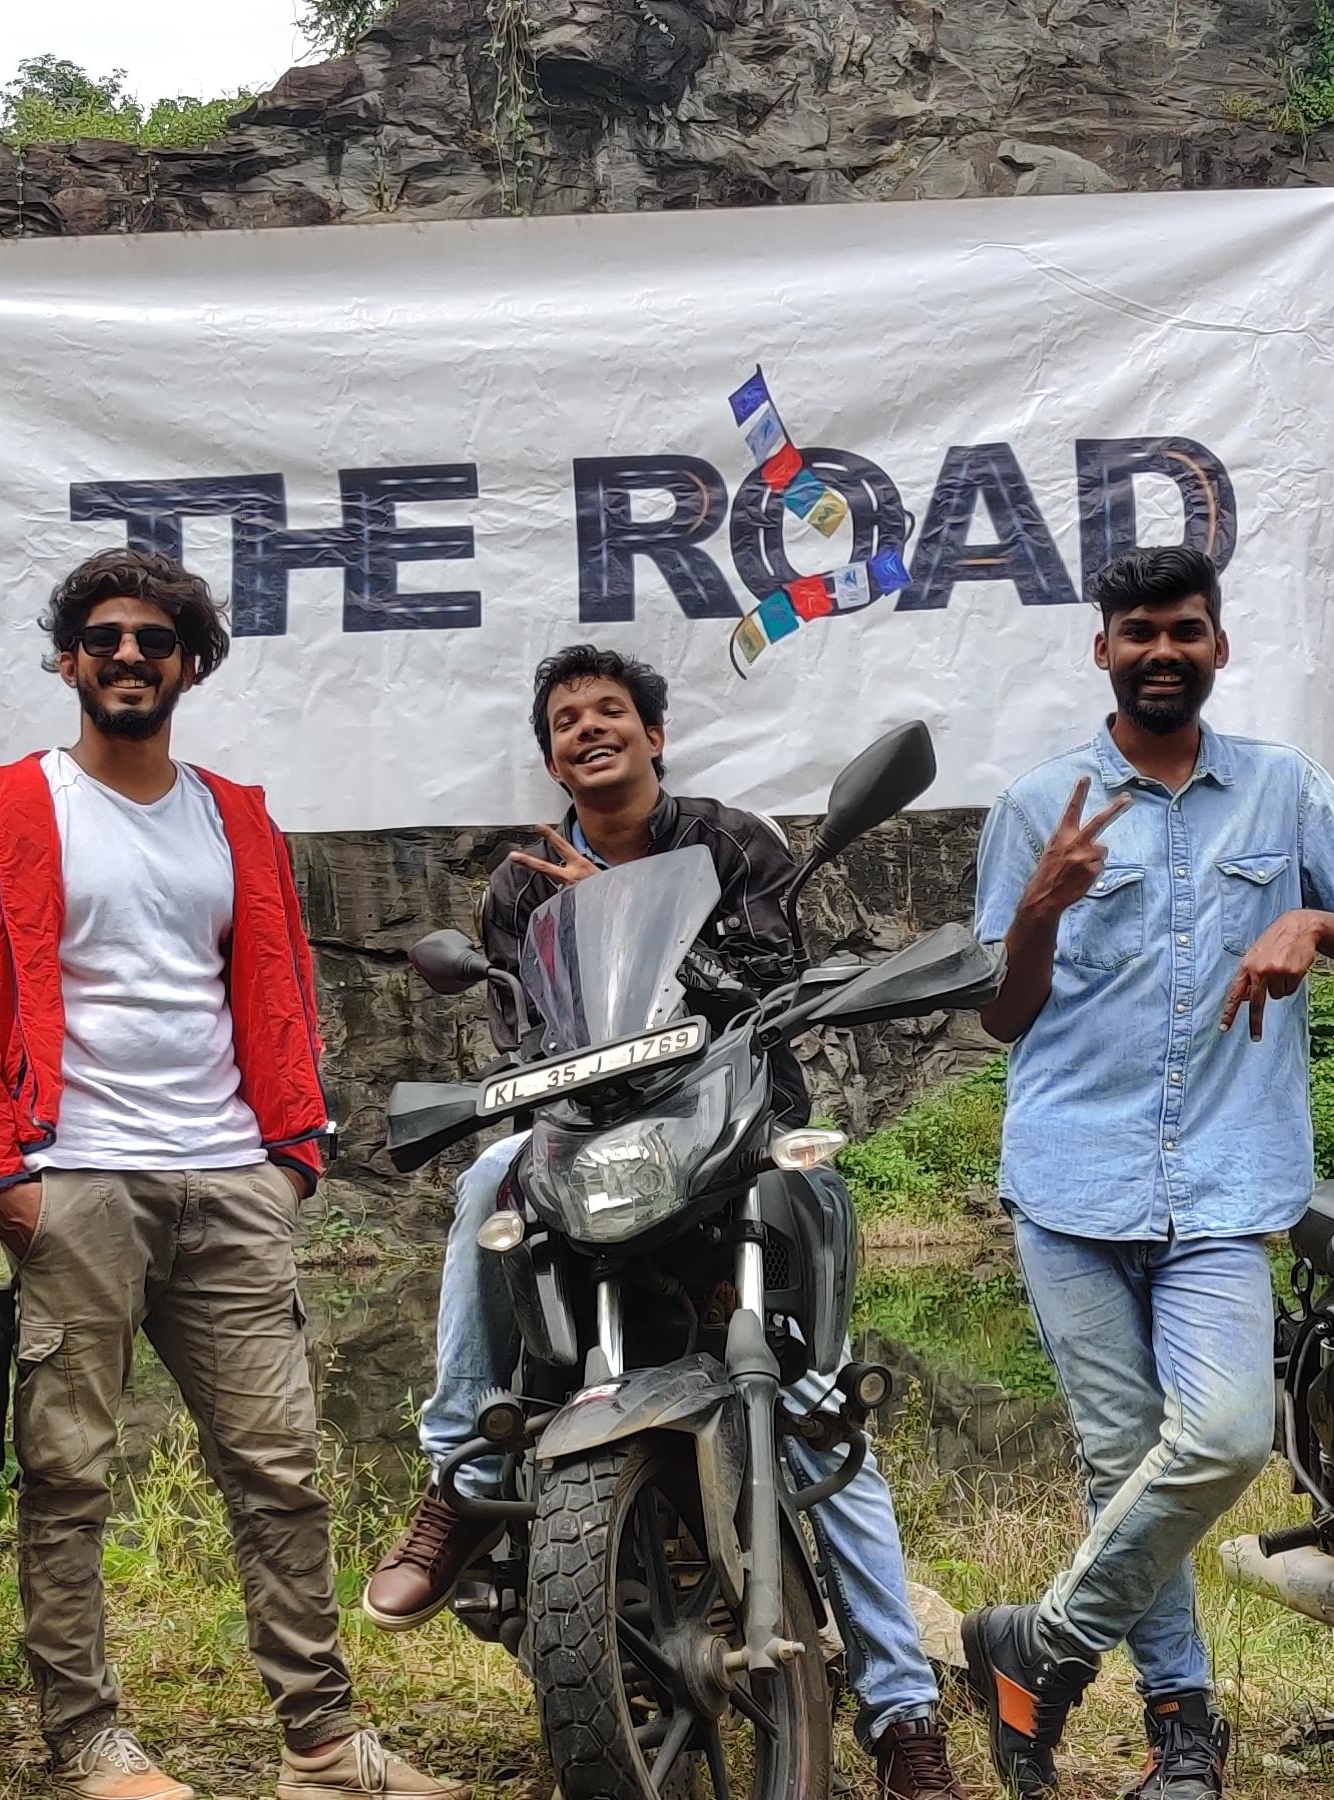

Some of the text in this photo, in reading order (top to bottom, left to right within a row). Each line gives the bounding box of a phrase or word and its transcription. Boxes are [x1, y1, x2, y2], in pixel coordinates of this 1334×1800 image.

[68, 435, 1239, 639] THE ROAD
[494, 1031, 690, 1107] KL 35 J 1769
